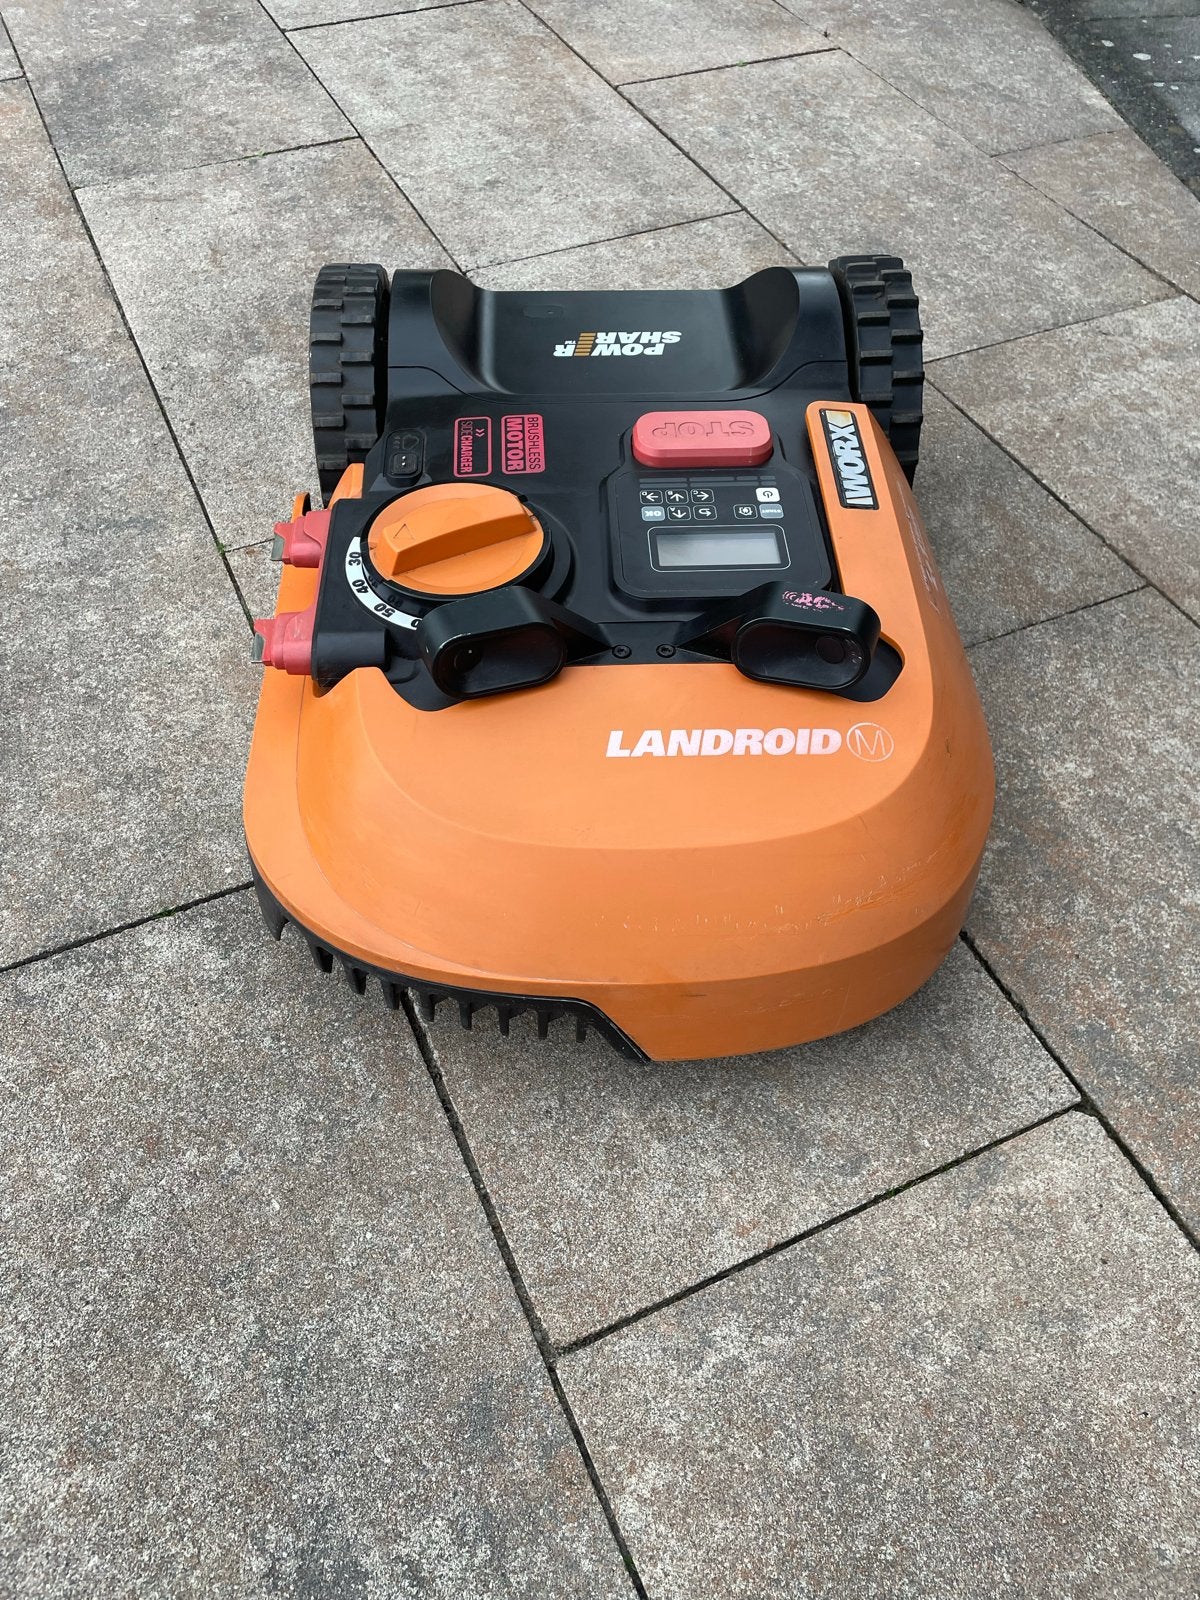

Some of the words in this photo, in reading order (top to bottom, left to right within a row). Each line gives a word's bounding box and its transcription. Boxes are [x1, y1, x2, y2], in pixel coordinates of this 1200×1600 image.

[652, 421, 755, 438] STOP
[506, 416, 525, 471] MOTOR
[527, 416, 541, 470] BRUSHLESS
[828, 423, 874, 505] WORX
[348, 551, 361, 566] 30
[352, 579, 369, 593] 40
[373, 603, 396, 618] 50
[606, 728, 842, 757] LANDROID
[854, 729, 885, 756] M
